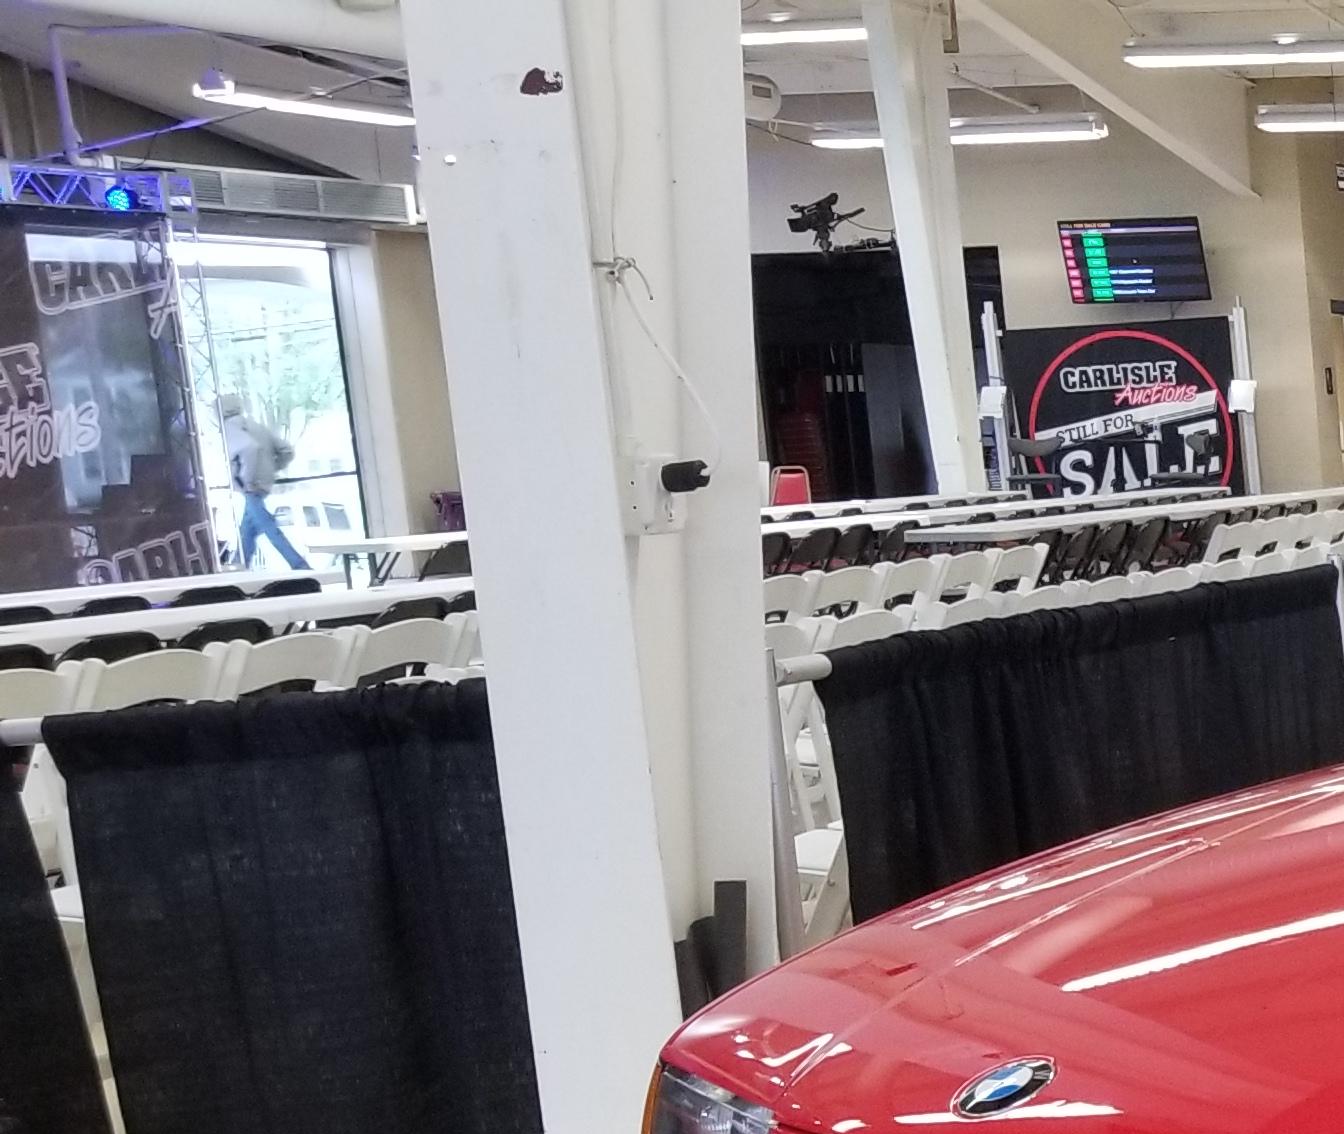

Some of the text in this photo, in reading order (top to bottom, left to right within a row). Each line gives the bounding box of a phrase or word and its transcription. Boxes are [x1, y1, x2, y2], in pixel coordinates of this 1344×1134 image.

[1061, 362, 1177, 392] CARLISLE
[1114, 384, 1199, 407] Auctions
[1055, 413, 1135, 446] STILL FOR
[1060, 419, 1222, 498] SALE
